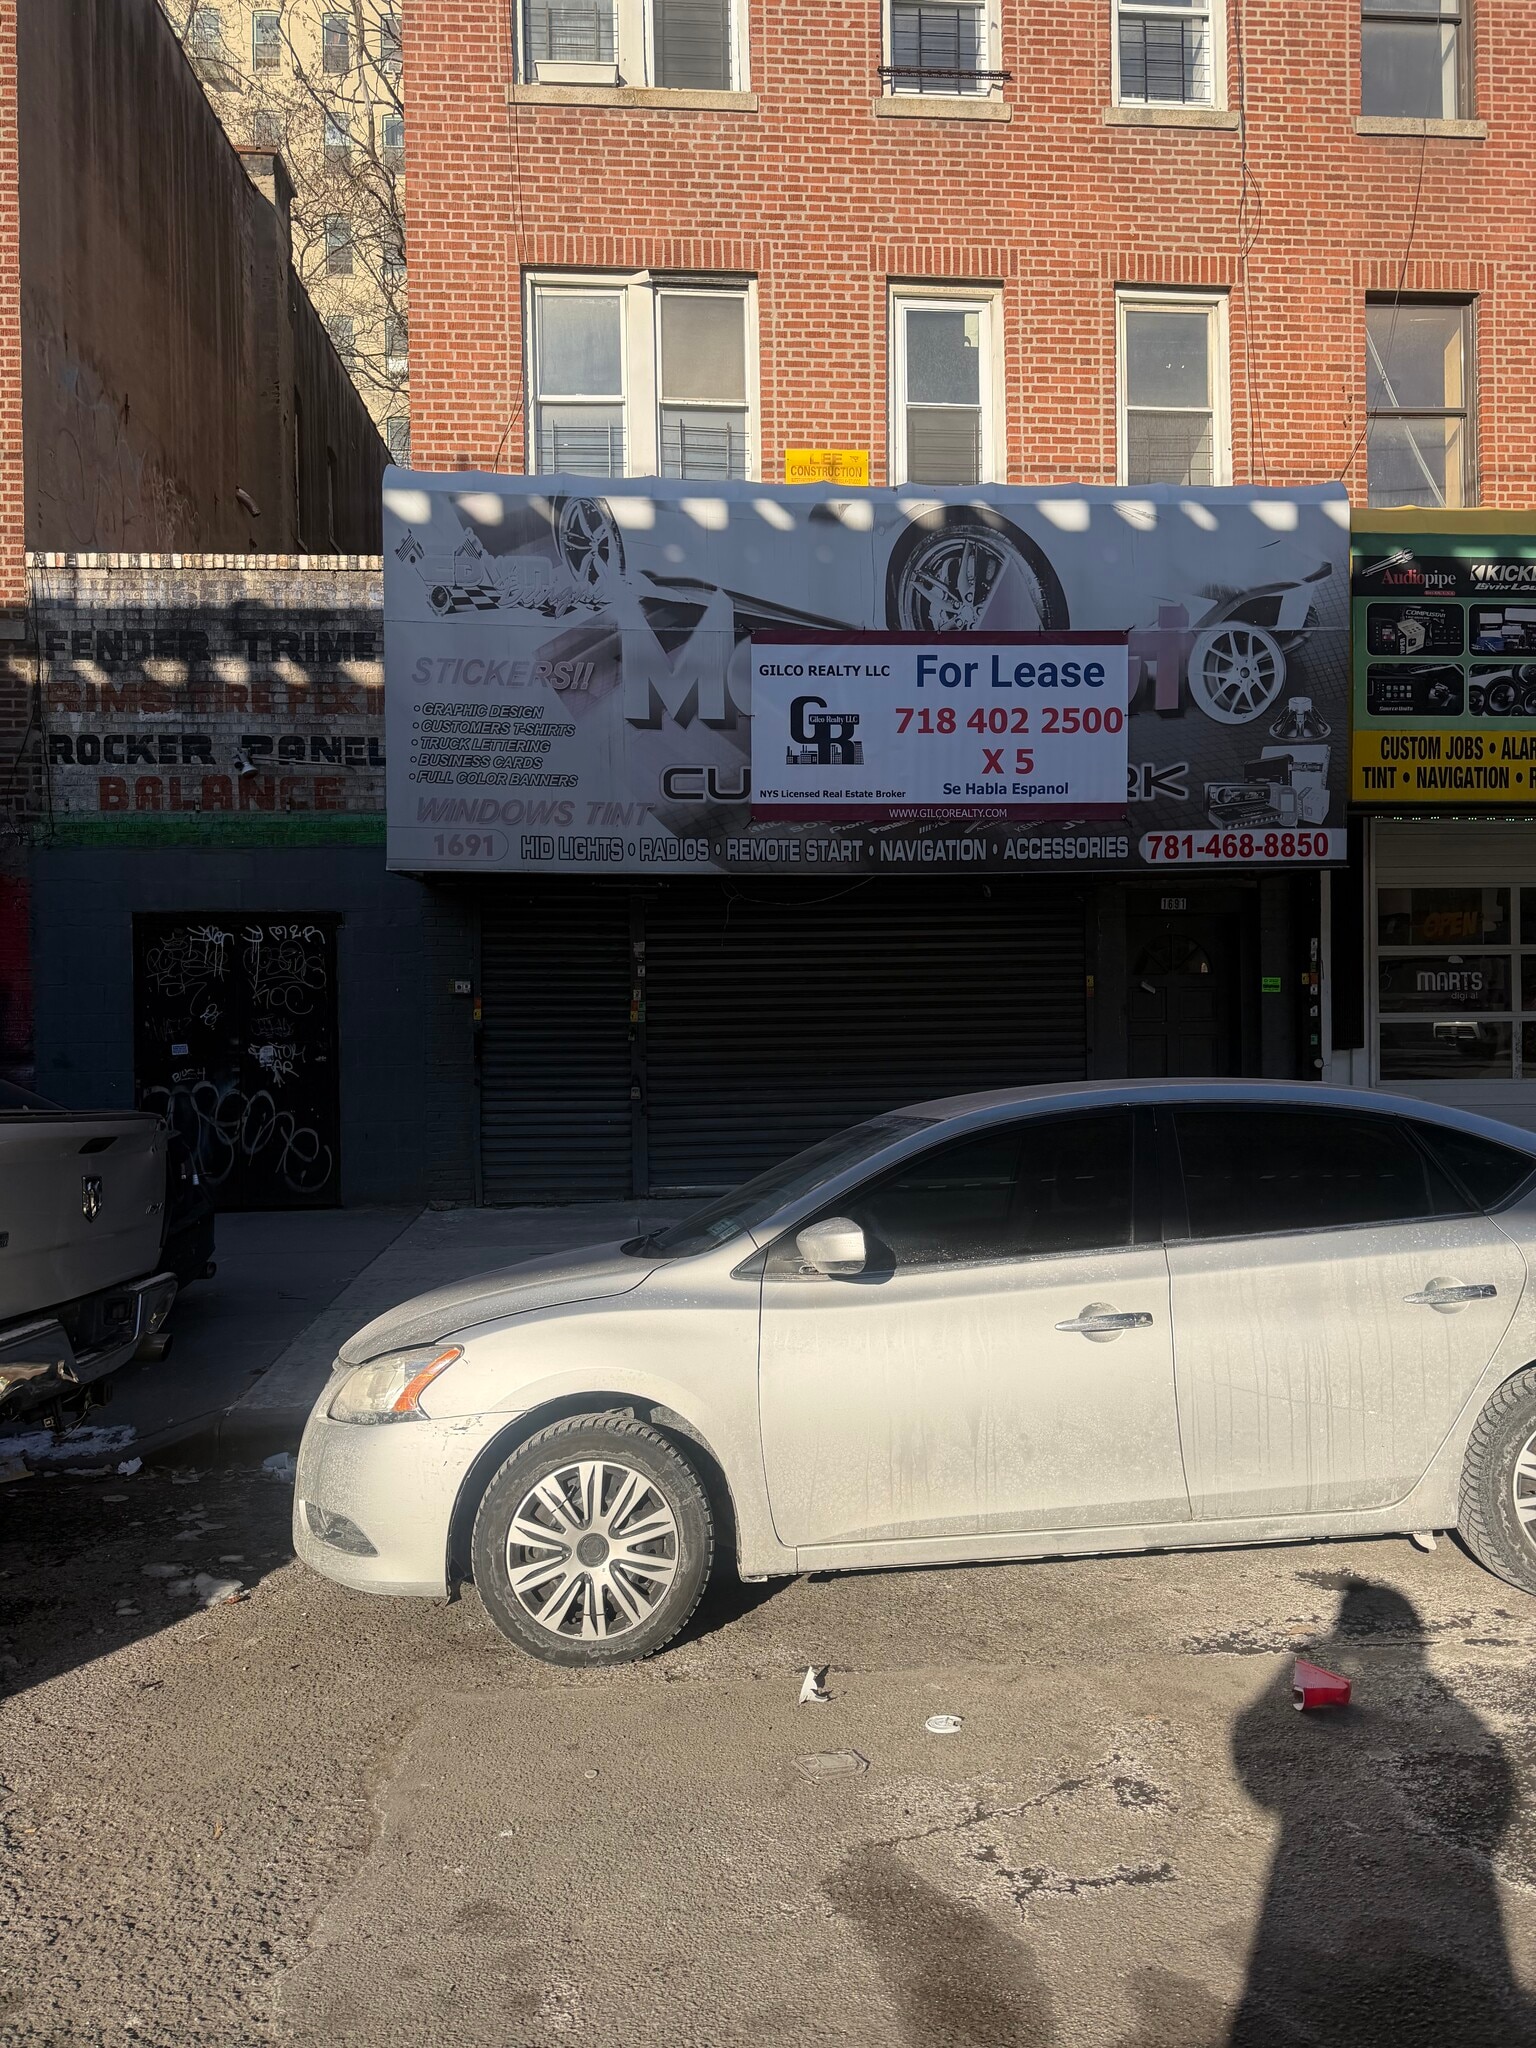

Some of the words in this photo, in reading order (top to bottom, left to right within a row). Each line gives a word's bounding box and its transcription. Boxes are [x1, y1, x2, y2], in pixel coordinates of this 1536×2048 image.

[790, 465, 862, 478] CONSTRUCTION
[1382, 569, 1456, 588] Audiopipe
[46, 630, 210, 661] FENDER
[411, 656, 595, 690] STICKERS!!
[759, 664, 803, 677] GILCO
[808, 665, 860, 677] REALTY
[861, 665, 891, 677] LLC
[916, 654, 978, 688] For
[991, 655, 1105, 688] Lease
[422, 703, 488, 718] GRAPHIC
[489, 705, 544, 719] DESIGN
[809, 715, 825, 723] Gilco
[826, 716, 844, 724] Realty
[895, 708, 957, 734] 718
[967, 708, 1029, 734] 402
[1041, 707, 1124, 734] 2500
[421, 720, 510, 735] CUSTOMERS
[513, 723, 576, 737] T-SHIRTS
[50, 734, 217, 765] ROCKER
[420, 737, 471, 751] TRUCK
[472, 738, 551, 753] LETTERING
[1381, 736, 1441, 760] CUSTOM
[1445, 736, 1484, 760] JOBS
[418, 754, 490, 768] BUSINESS
[493, 756, 543, 769] CARDS
[982, 748, 1005, 775] X
[1015, 748, 1035, 775] 5
[417, 770, 454, 784] FULL
[456, 771, 507, 786] COLOR
[509, 773, 578, 788] BANNERS
[1362, 766, 1397, 789] TINT
[1416, 766, 1509, 789] NAVIGATION
[100, 775, 347, 812] BALANCE
[760, 789, 779, 798] NYS
[781, 789, 820, 798] Licensed
[823, 789, 843, 798] Real
[845, 789, 873, 798] Estate
[875, 789, 906, 798] Broker
[943, 783, 962, 796] Se
[965, 782, 1007, 796] Habla
[1012, 782, 1069, 797] Espanol
[416, 797, 576, 826] WINDOWS
[585, 802, 656, 828] TINT
[888, 808, 1008, 818] WWW.GILCOREALTY.COM
[433, 834, 494, 857] 1691
[521, 835, 555, 861] HID
[558, 836, 624, 862] LIGHTS
[640, 837, 709, 862] RADIOS
[727, 838, 800, 862] REMOTE
[805, 839, 863, 862] START
[880, 838, 987, 862] NAVIGATION
[1003, 836, 1129, 861] ACCESSORIES
[1147, 831, 1329, 860] 781-468-8850
[1162, 898, 1186, 909] 1691
[1423, 911, 1479, 937] OPEN
[1417, 971, 1483, 991] MARTS
